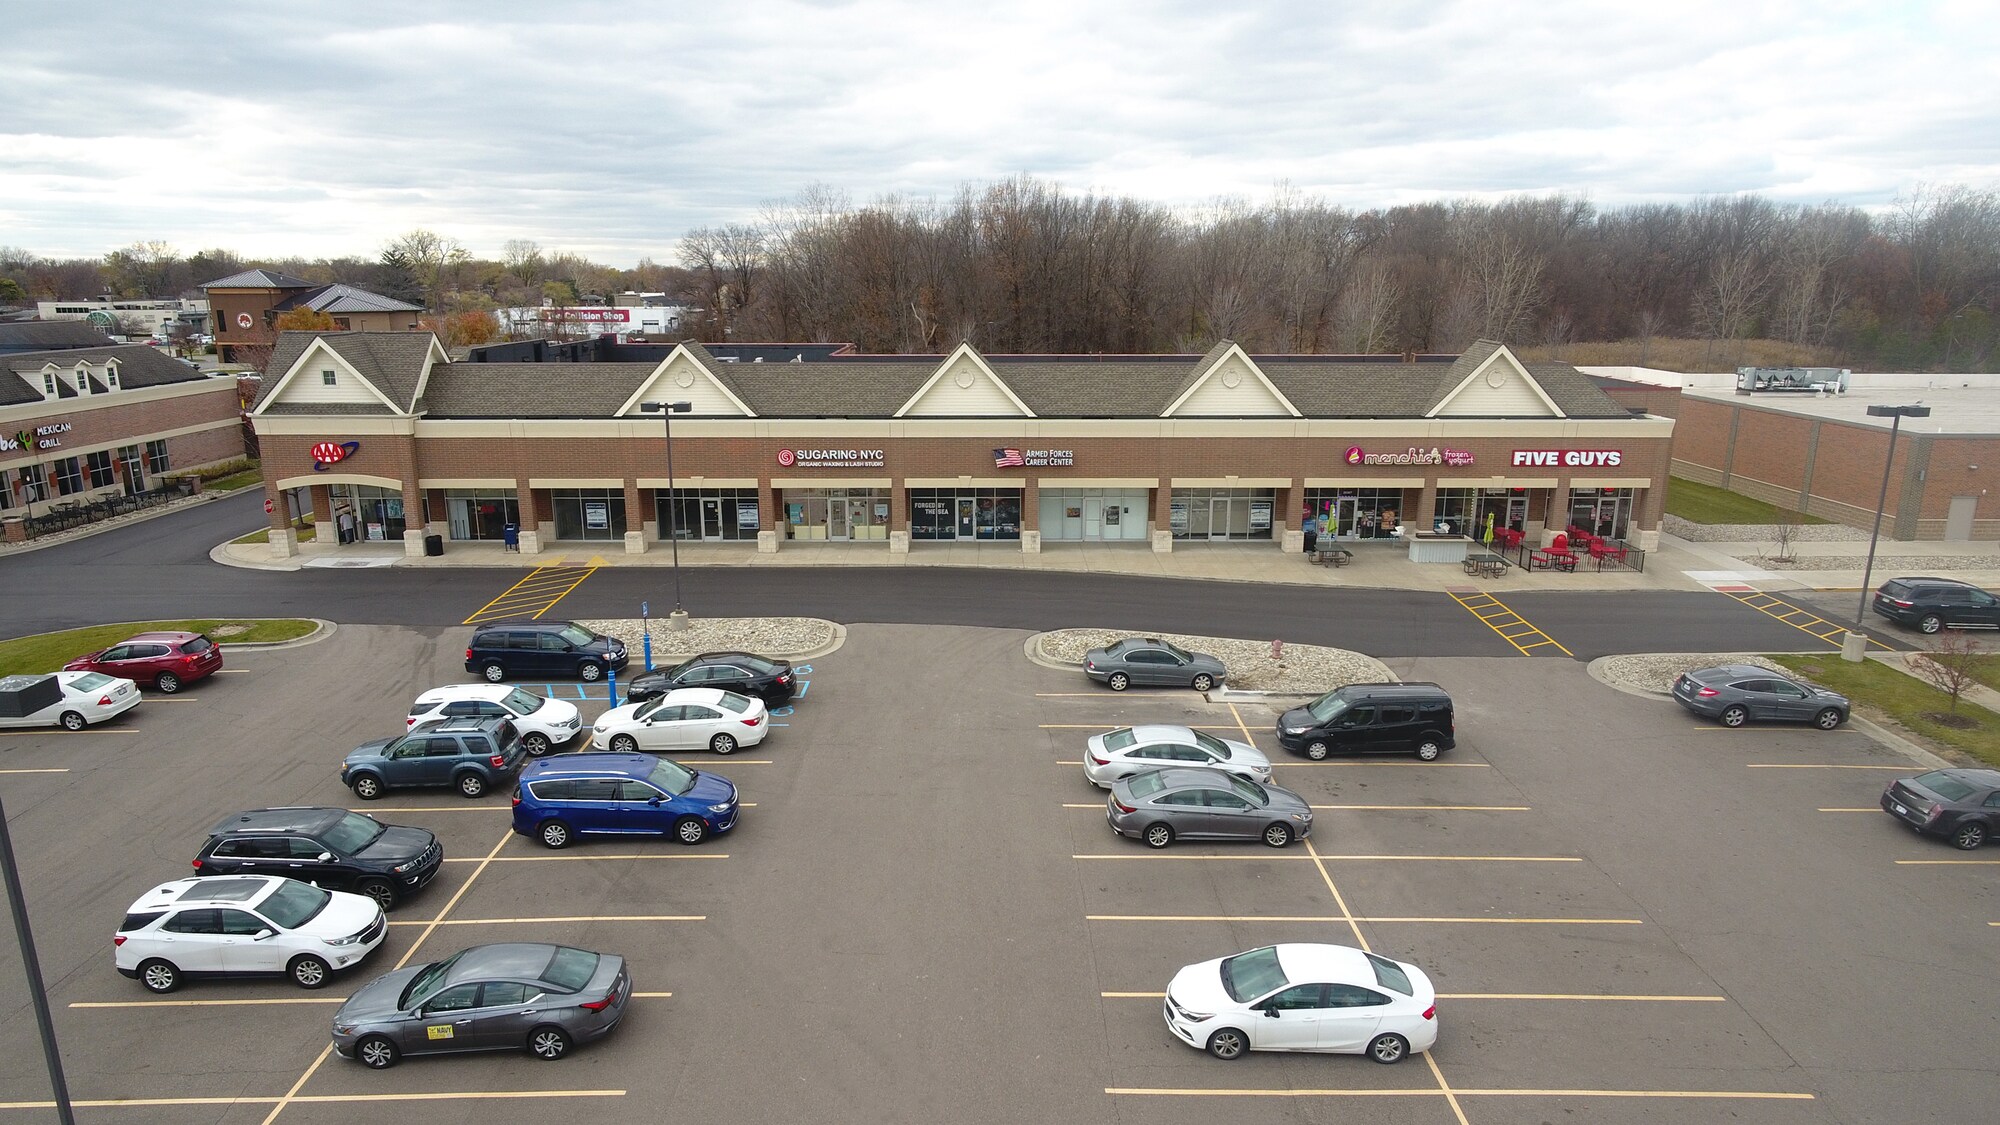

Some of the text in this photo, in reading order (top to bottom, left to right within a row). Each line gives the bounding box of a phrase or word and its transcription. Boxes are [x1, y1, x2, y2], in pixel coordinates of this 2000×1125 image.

[37, 422, 72, 436] MEXICAN
[39, 437, 62, 449] GRILL
[313, 443, 342, 462] AAA
[797, 449, 884, 460] SUGARING NYC
[1026, 449, 1074, 458] ARMED FORCES
[1364, 447, 1442, 465] menchie's
[1444, 449, 1470, 459] frozen
[1025, 457, 1074, 466] CAREER CENTER
[1448, 457, 1474, 467] yogurt
[1513, 451, 1621, 466] FIVE GUYS
